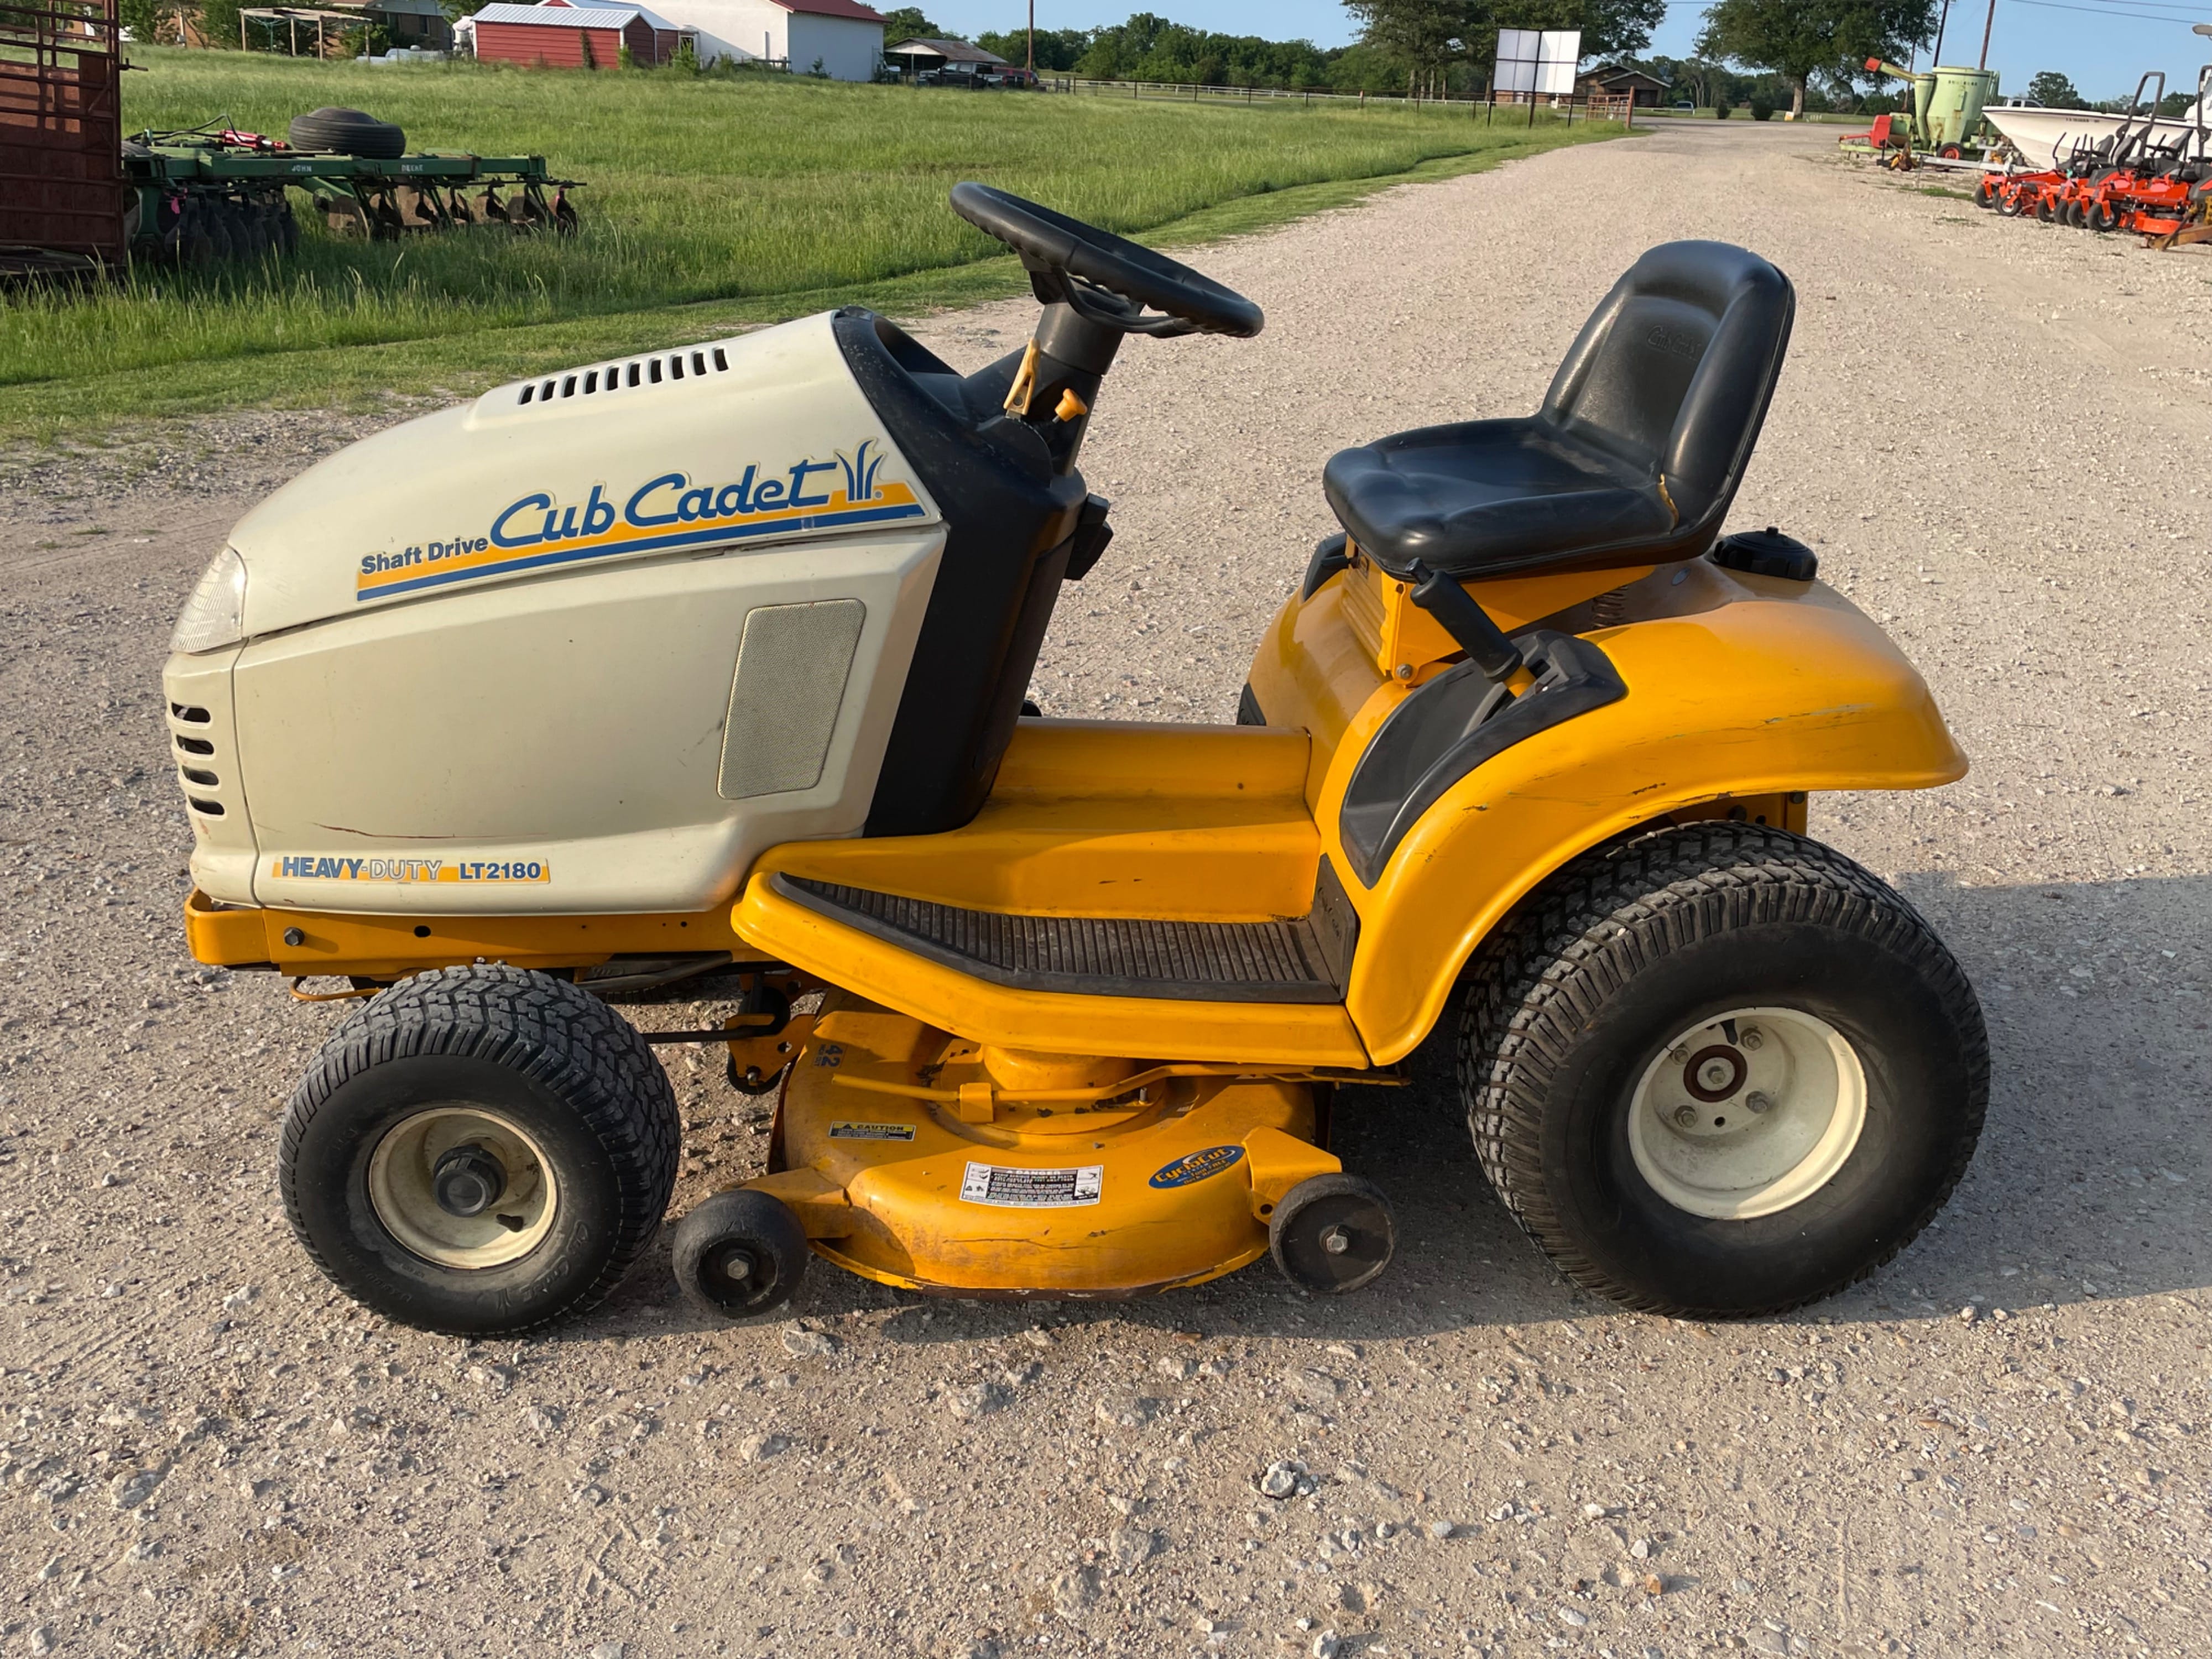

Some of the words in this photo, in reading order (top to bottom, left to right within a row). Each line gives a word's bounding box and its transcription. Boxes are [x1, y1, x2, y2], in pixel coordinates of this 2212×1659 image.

[491, 484, 617, 548] Cub
[624, 460, 838, 526] Cadet
[362, 546, 422, 575] Shaft
[428, 538, 489, 561] Drive
[282, 857, 442, 880] HEAVY-DUTY
[459, 862, 541, 879] LT2180
[822, 1045, 843, 1067] 42
